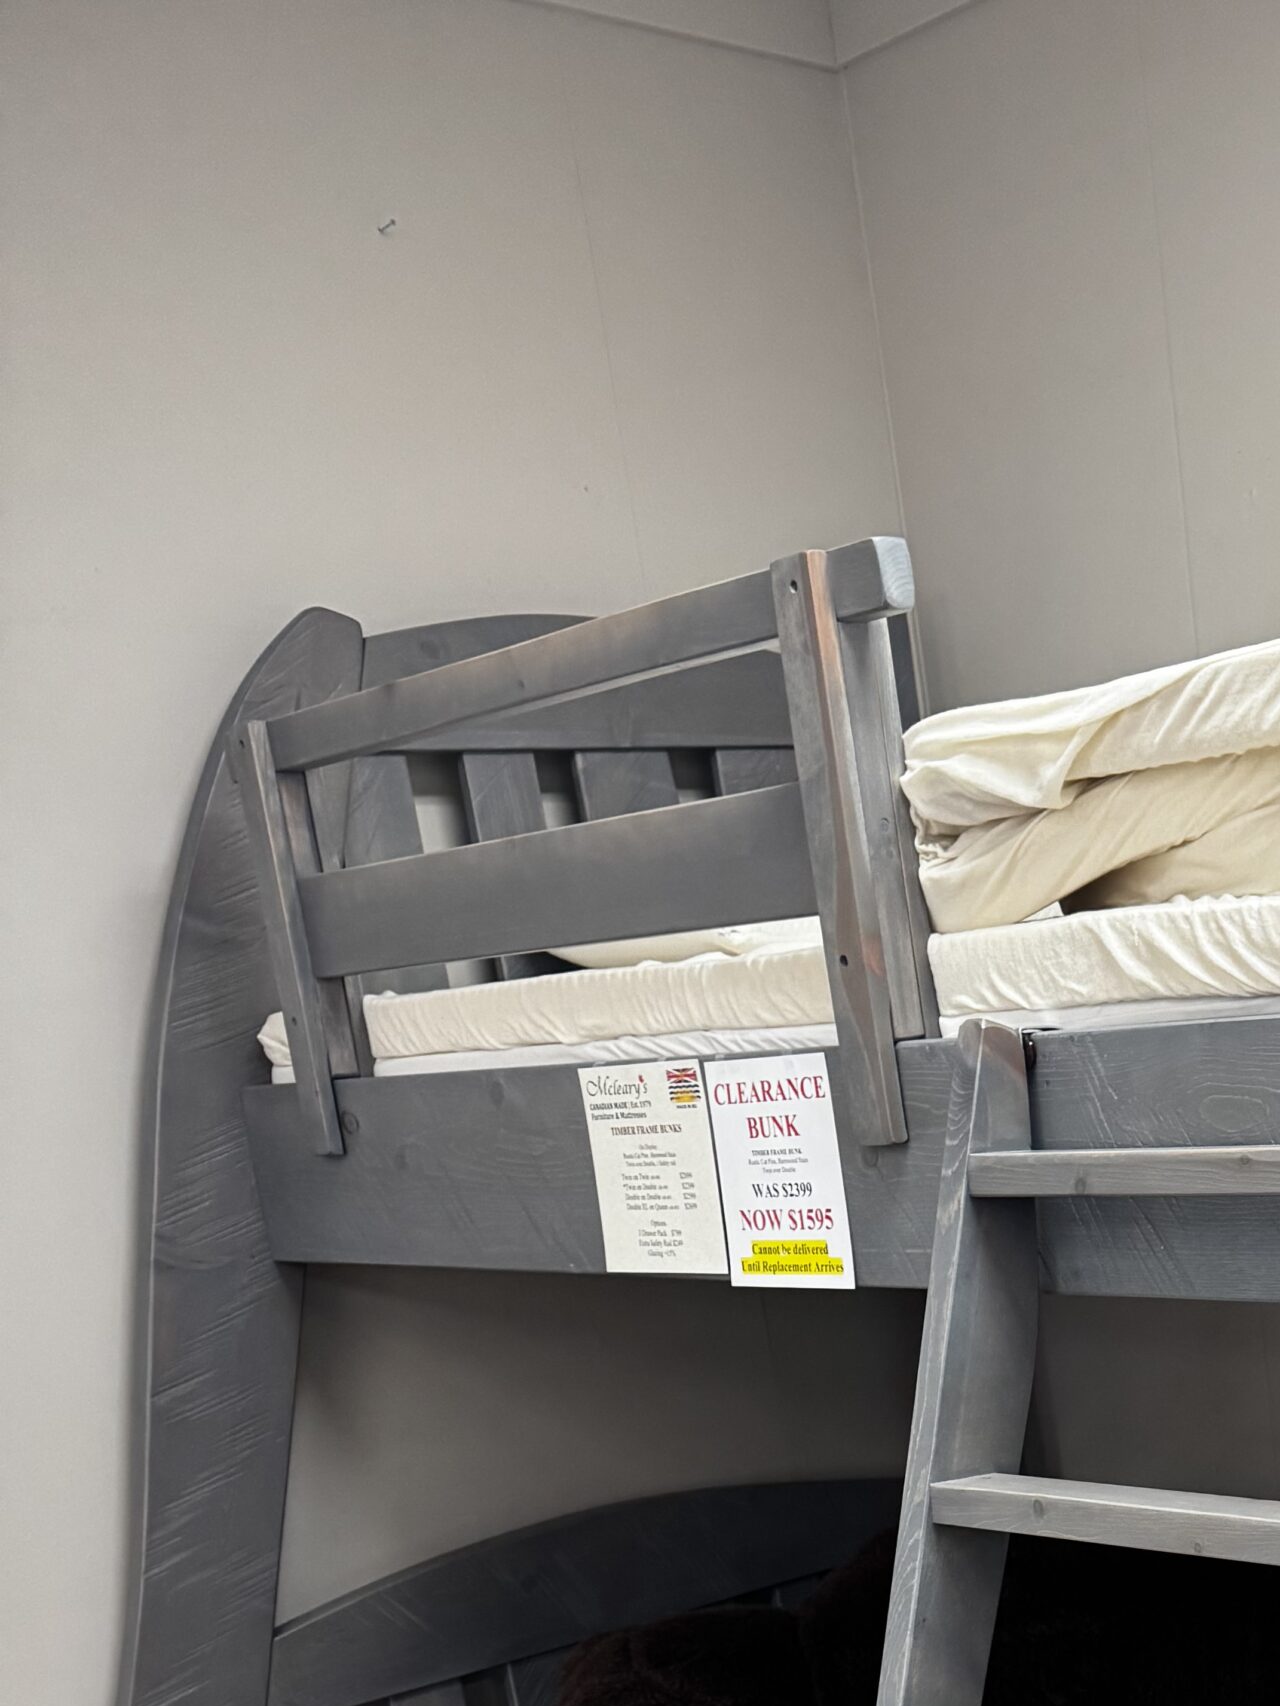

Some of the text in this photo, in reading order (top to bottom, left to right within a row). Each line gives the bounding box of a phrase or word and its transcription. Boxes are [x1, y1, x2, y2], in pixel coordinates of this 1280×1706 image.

[714, 1075, 826, 1105] CLEARANCE
[610, 1124, 682, 1136] TIMBER FRAME BUNKS
[746, 1114, 801, 1138] BUNK
[752, 1181, 812, 1198] WAS $2399
[739, 1208, 834, 1231] NOW $1595
[752, 1243, 829, 1255] Cannot be delivered
[741, 1260, 844, 1275] Until Replacement Arrives
